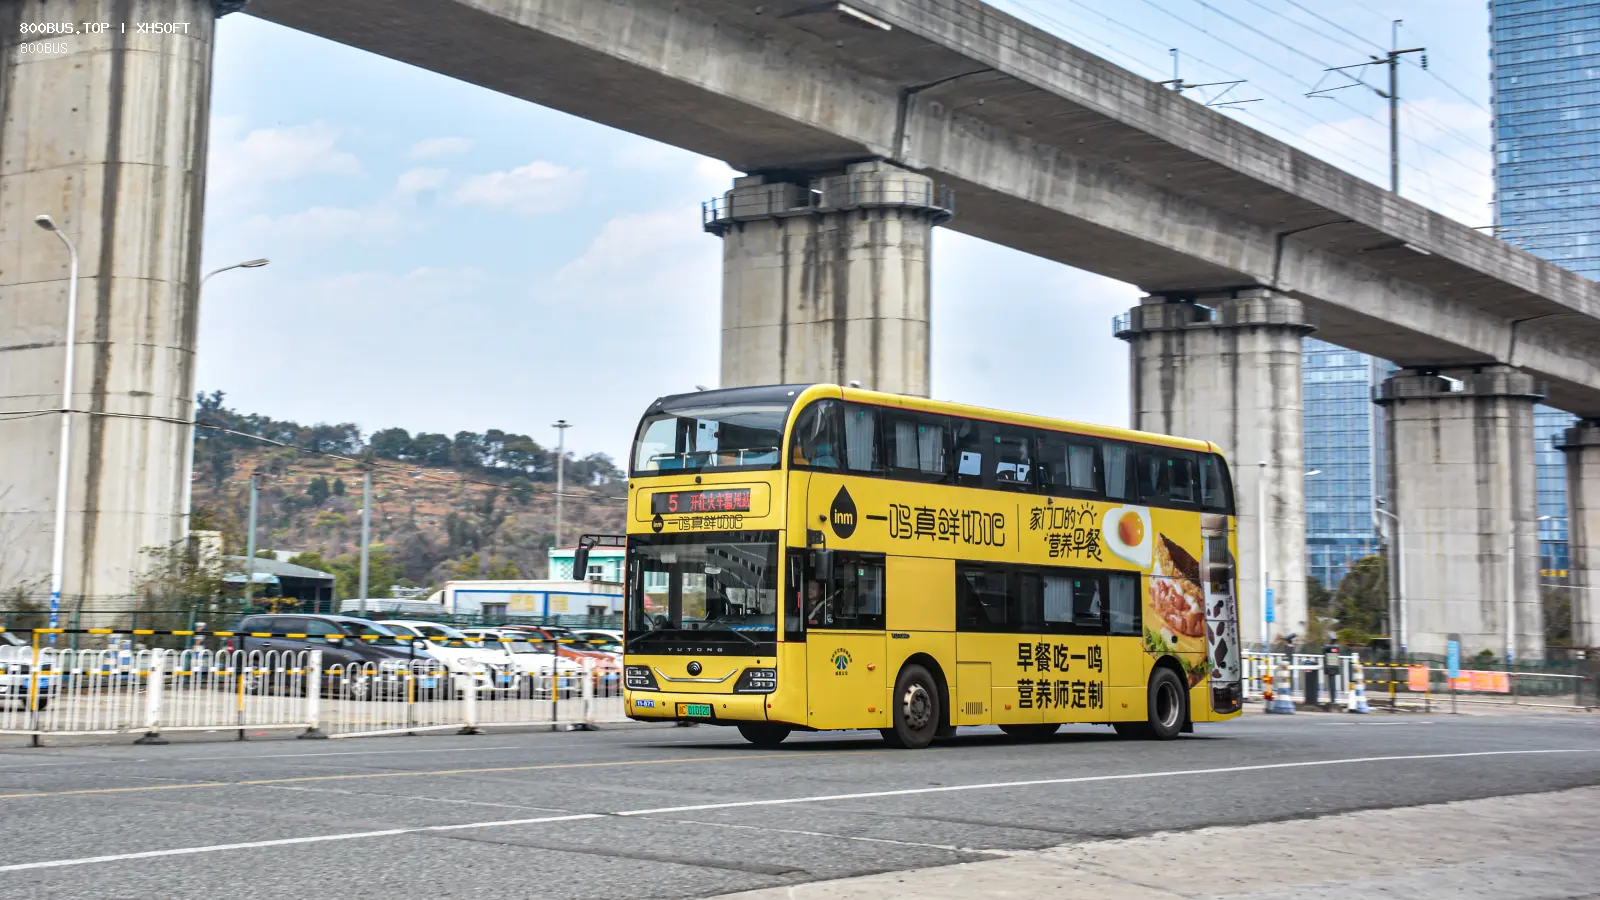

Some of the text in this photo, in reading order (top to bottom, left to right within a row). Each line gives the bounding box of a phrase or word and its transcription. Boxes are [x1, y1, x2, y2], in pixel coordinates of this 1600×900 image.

[669, 494, 678, 512] 5
[668, 514, 743, 530] 一鸣真鲜奶吧
[834, 509, 854, 525] inm
[865, 503, 1006, 547] 一鸣真鲜奶吧
[1029, 506, 1076, 531] 家门口的
[1044, 528, 1102, 562] 营养早餐
[1017, 642, 1103, 672] 早餐吃一鸣
[1017, 679, 1103, 709] 营养师定制
